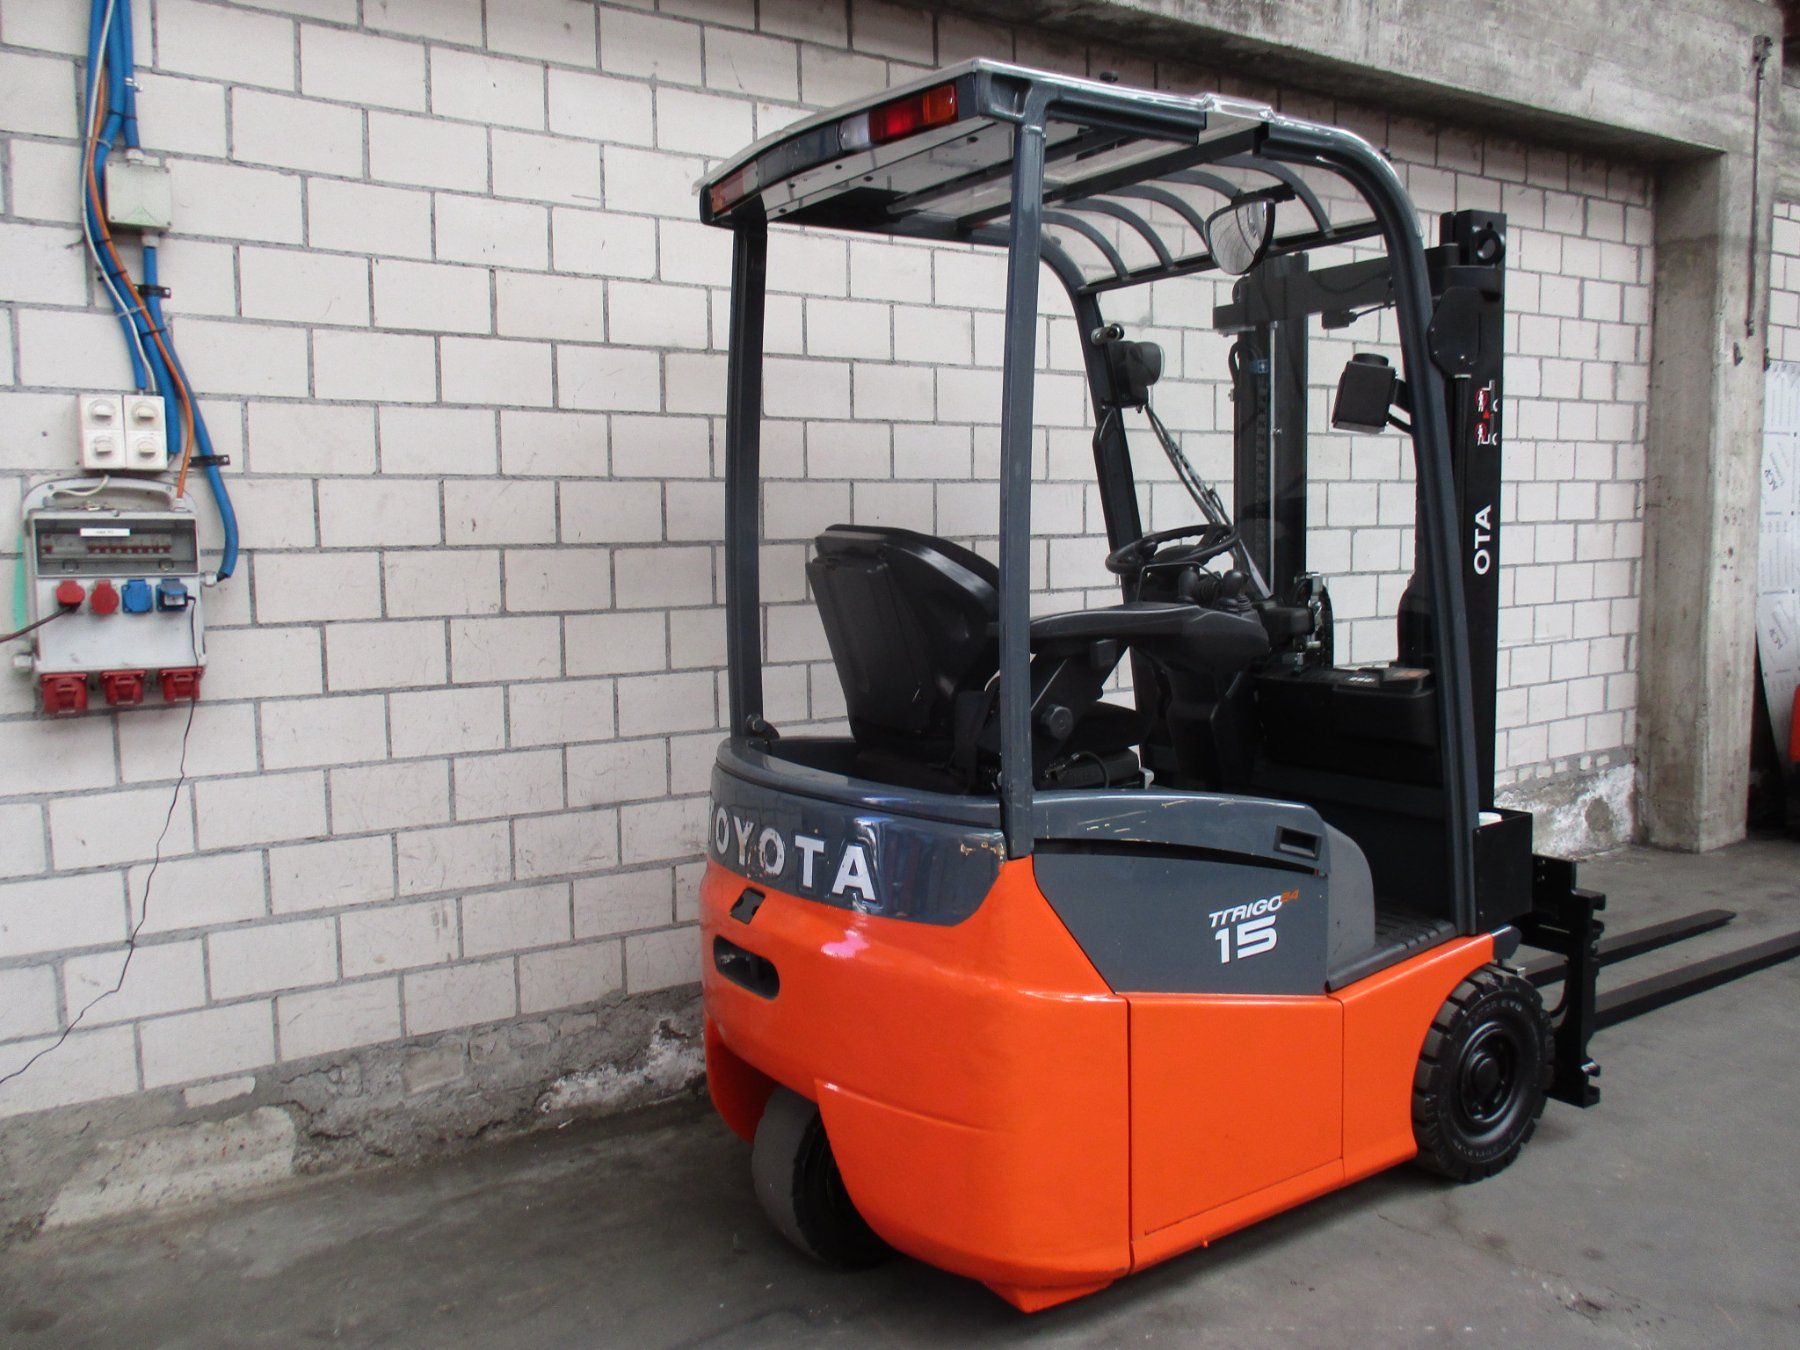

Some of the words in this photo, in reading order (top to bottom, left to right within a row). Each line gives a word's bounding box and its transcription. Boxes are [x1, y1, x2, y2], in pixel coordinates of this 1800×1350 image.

[1473, 504, 1492, 576] OTA
[709, 798, 877, 901] OYOTA
[1214, 914, 1278, 964] 15
